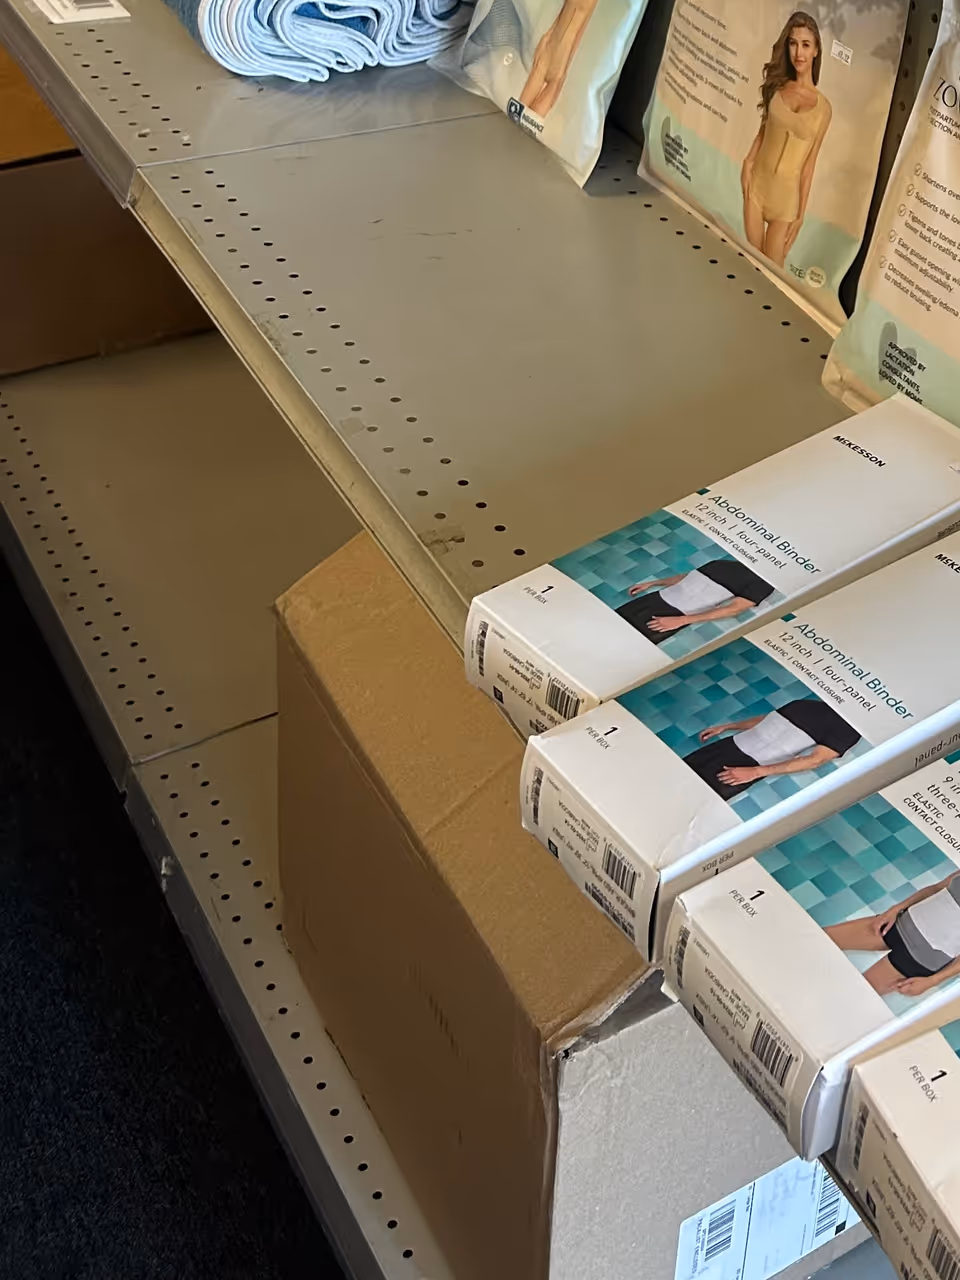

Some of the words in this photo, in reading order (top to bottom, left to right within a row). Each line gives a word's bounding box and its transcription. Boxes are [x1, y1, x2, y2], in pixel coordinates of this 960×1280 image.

[884, 350, 914, 376] LACTATION
[887, 341, 917, 366] APPROVED
[916, 362, 926, 371] BY
[878, 368, 896, 385] LOVED
[896, 382, 905, 392] BY
[694, 502, 709, 512] 12
[705, 509, 726, 524] inch
[736, 530, 787, 569] four-panel
[707, 495, 780, 543] Abdominal
[776, 540, 820, 573] Binder
[778, 631, 794, 642] 12
[789, 640, 812, 658] inch
[821, 665, 876, 711] four-panel
[793, 623, 870, 680] Abdominal
[865, 677, 913, 718] Binder
[942, 775, 953, 783] 9
[903, 797, 937, 825] CONTACT
[912, 791, 944, 818] ELASTIC
[729, 888, 746, 905] PER
[742, 901, 758, 918] BOX
[750, 890, 765, 901] 1
[909, 1065, 926, 1084] PER
[921, 1081, 938, 1103] BOX
[931, 1070, 947, 1082] 1
